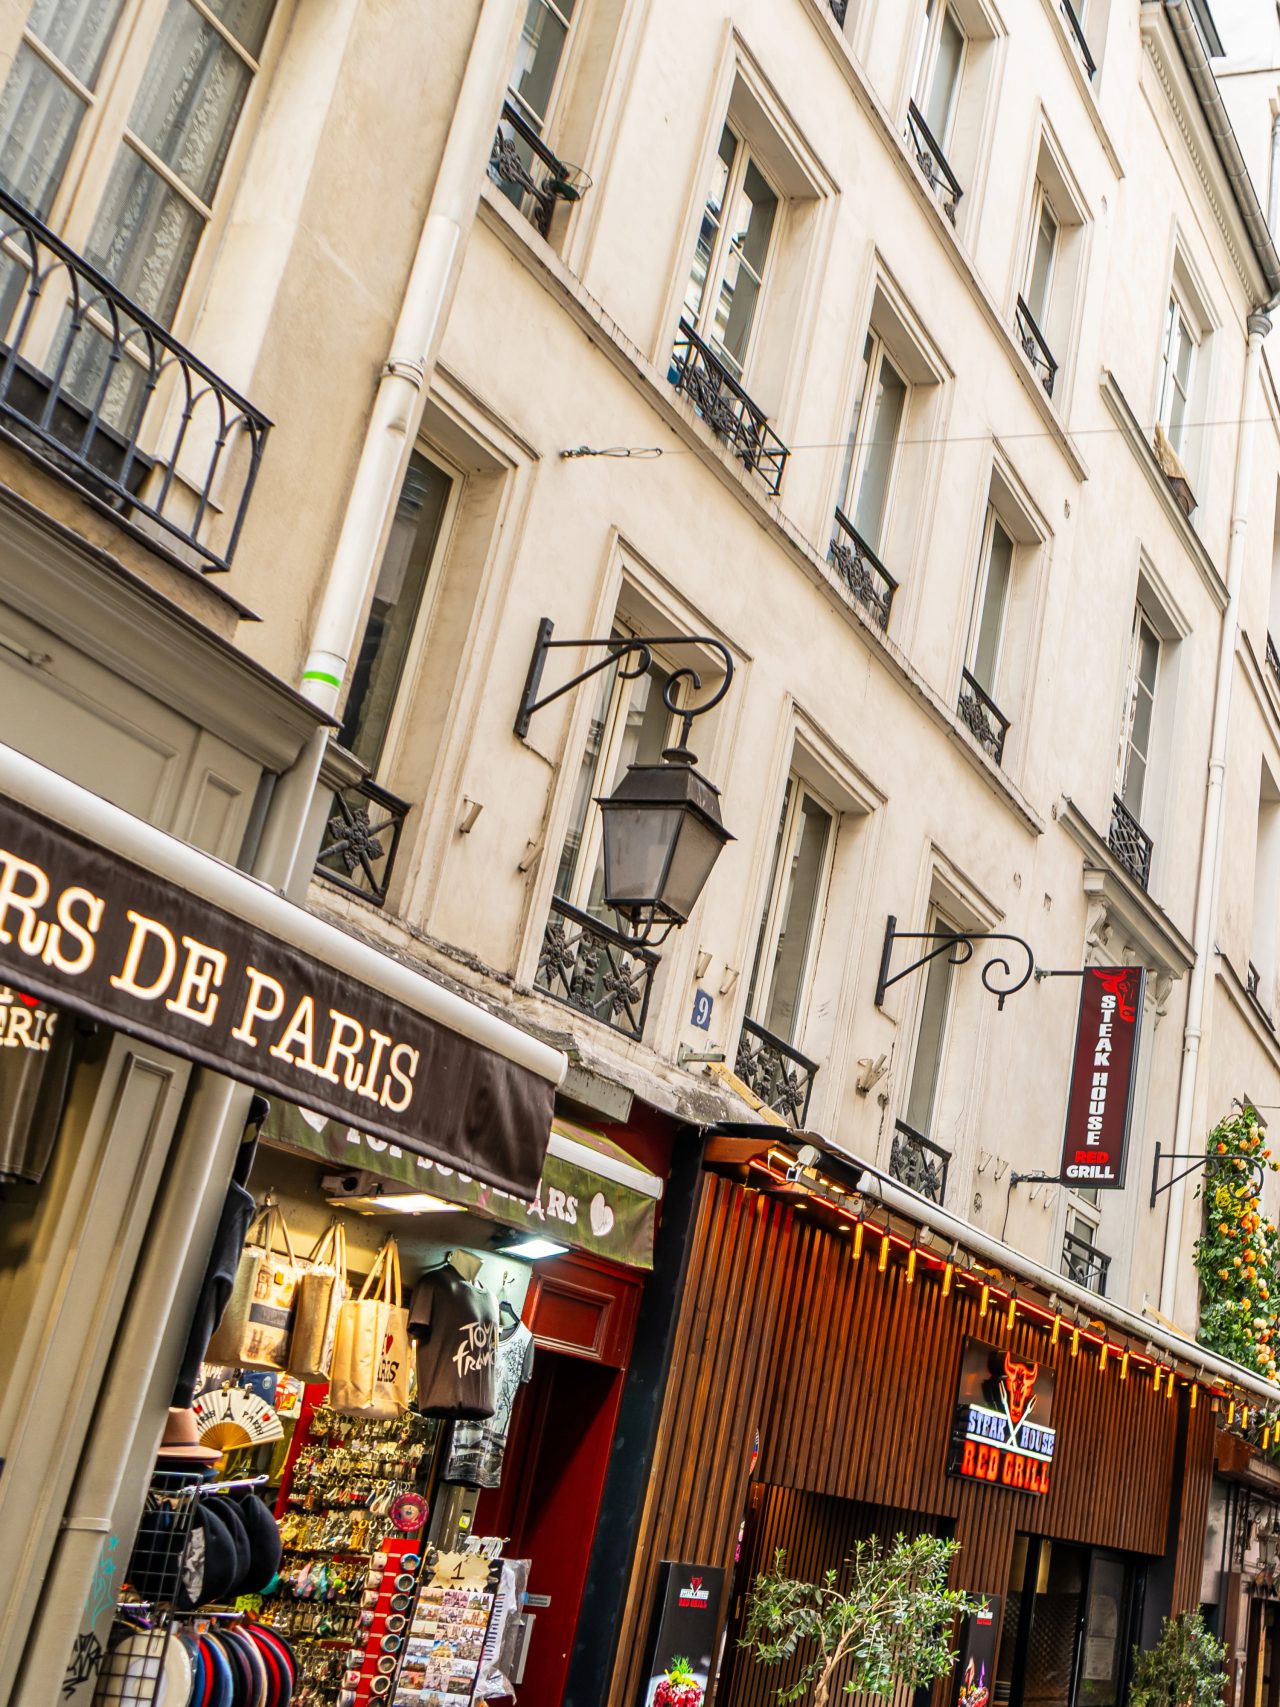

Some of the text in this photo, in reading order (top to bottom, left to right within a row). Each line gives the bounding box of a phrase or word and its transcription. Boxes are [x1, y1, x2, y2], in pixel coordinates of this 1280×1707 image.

[110, 909, 228, 1027] DE
[231, 965, 420, 1113] PARIS
[696, 996, 709, 1025] 9
[1086, 995, 1117, 1146] STEAK HOUSE
[1066, 1165, 1115, 1179] GRILL
[1074, 1151, 1110, 1164] RED
[967, 1409, 1055, 1456] STEAK HOUSE
[961, 1439, 1051, 1495] RED GRILL
